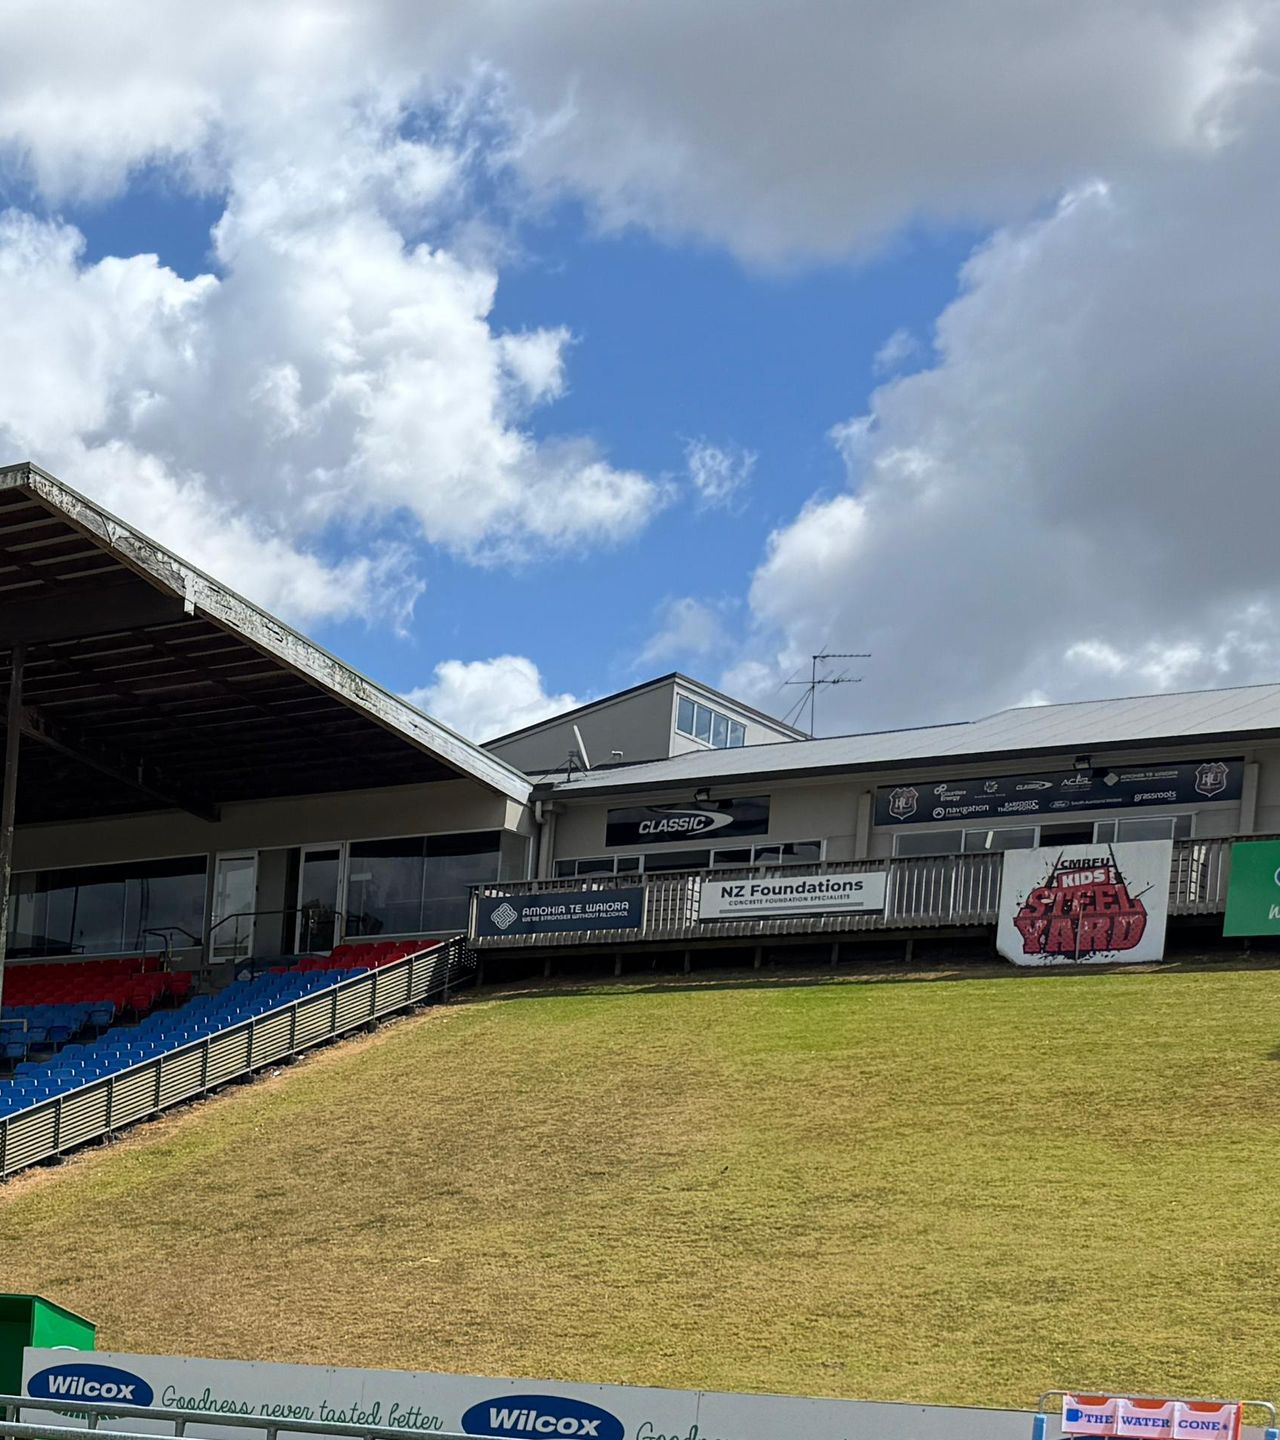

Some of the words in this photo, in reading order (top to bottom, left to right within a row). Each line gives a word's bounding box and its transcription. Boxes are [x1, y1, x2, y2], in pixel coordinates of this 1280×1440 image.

[1015, 783, 1041, 791] CLASSIC
[1134, 791, 1177, 802] grassroots
[946, 804, 989, 815] navigation
[638, 816, 706, 834] CLASSIC
[1060, 857, 1110, 869] CMRFU
[1061, 869, 1106, 888] KIDS
[721, 885, 745, 898] NZ
[750, 879, 863, 897] Foundations
[765, 896, 808, 904] FOUNDATION
[810, 893, 850, 901] SPECIALISTS
[1017, 884, 1147, 917] STEEL
[522, 905, 566, 915] AMOHIA
[570, 904, 583, 913] TE
[585, 901, 629, 912] WAIORA
[1013, 914, 1147, 954] YARD
[48, 1374, 136, 1400] Wilcox
[161, 1385, 256, 1415] Goodness
[260, 1397, 314, 1420] never
[319, 1399, 383, 1425] tasted
[388, 1402, 444, 1430] better
[490, 1407, 602, 1436] Wilcox
[1084, 1413, 1114, 1425] THE
[1121, 1415, 1170, 1428] WATER
[1178, 1418, 1220, 1431] CONE
